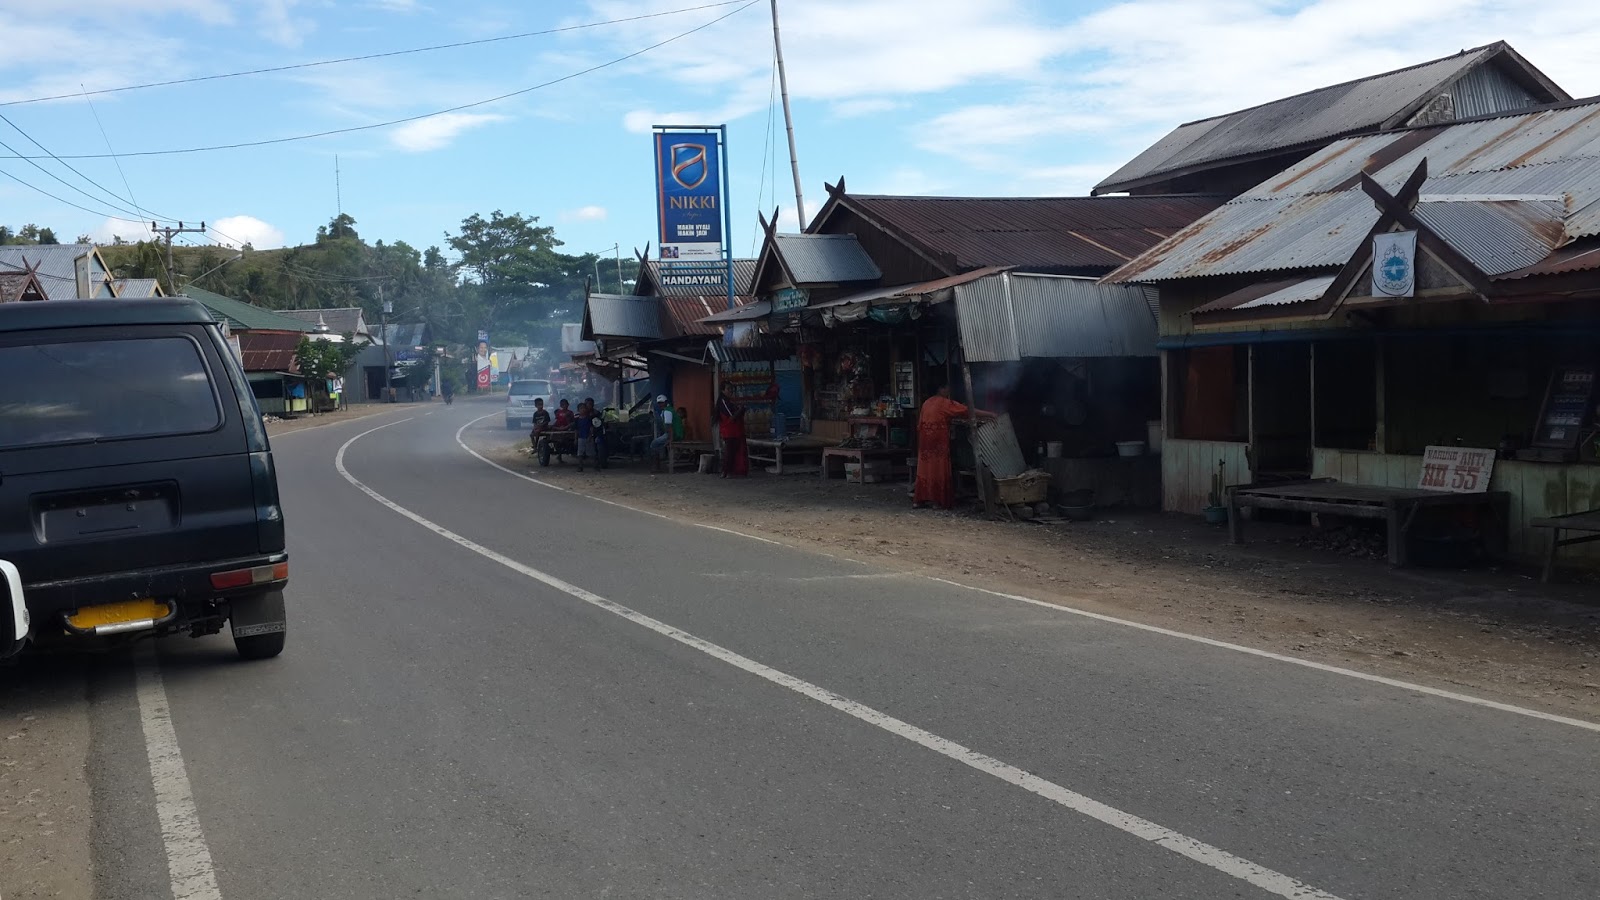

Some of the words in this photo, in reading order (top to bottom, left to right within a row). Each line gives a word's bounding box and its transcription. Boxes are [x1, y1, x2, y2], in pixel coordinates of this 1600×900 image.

[669, 196, 716, 209] NIKKI
[662, 275, 721, 285] HANDAYANI
[1451, 465, 1482, 490] 55
